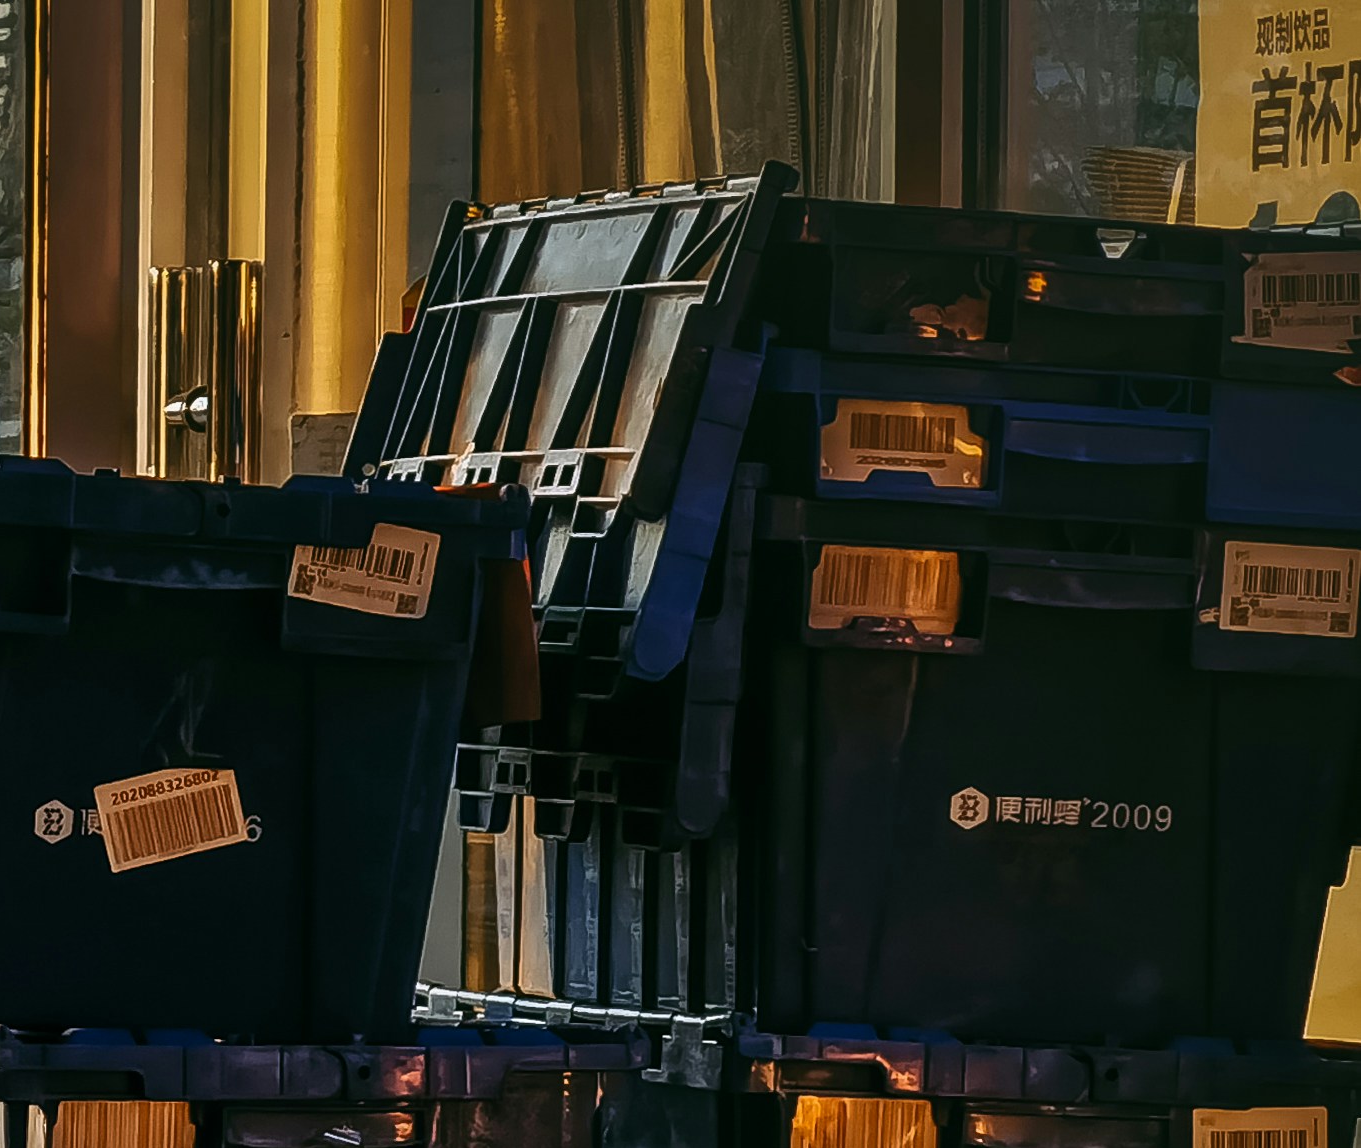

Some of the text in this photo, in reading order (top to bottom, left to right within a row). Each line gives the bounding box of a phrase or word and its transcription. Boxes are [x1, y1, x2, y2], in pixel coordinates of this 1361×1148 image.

[1255, 8, 1330, 55] 现制饮品
[996, 797, 1172, 832] 便利蜂 2009
